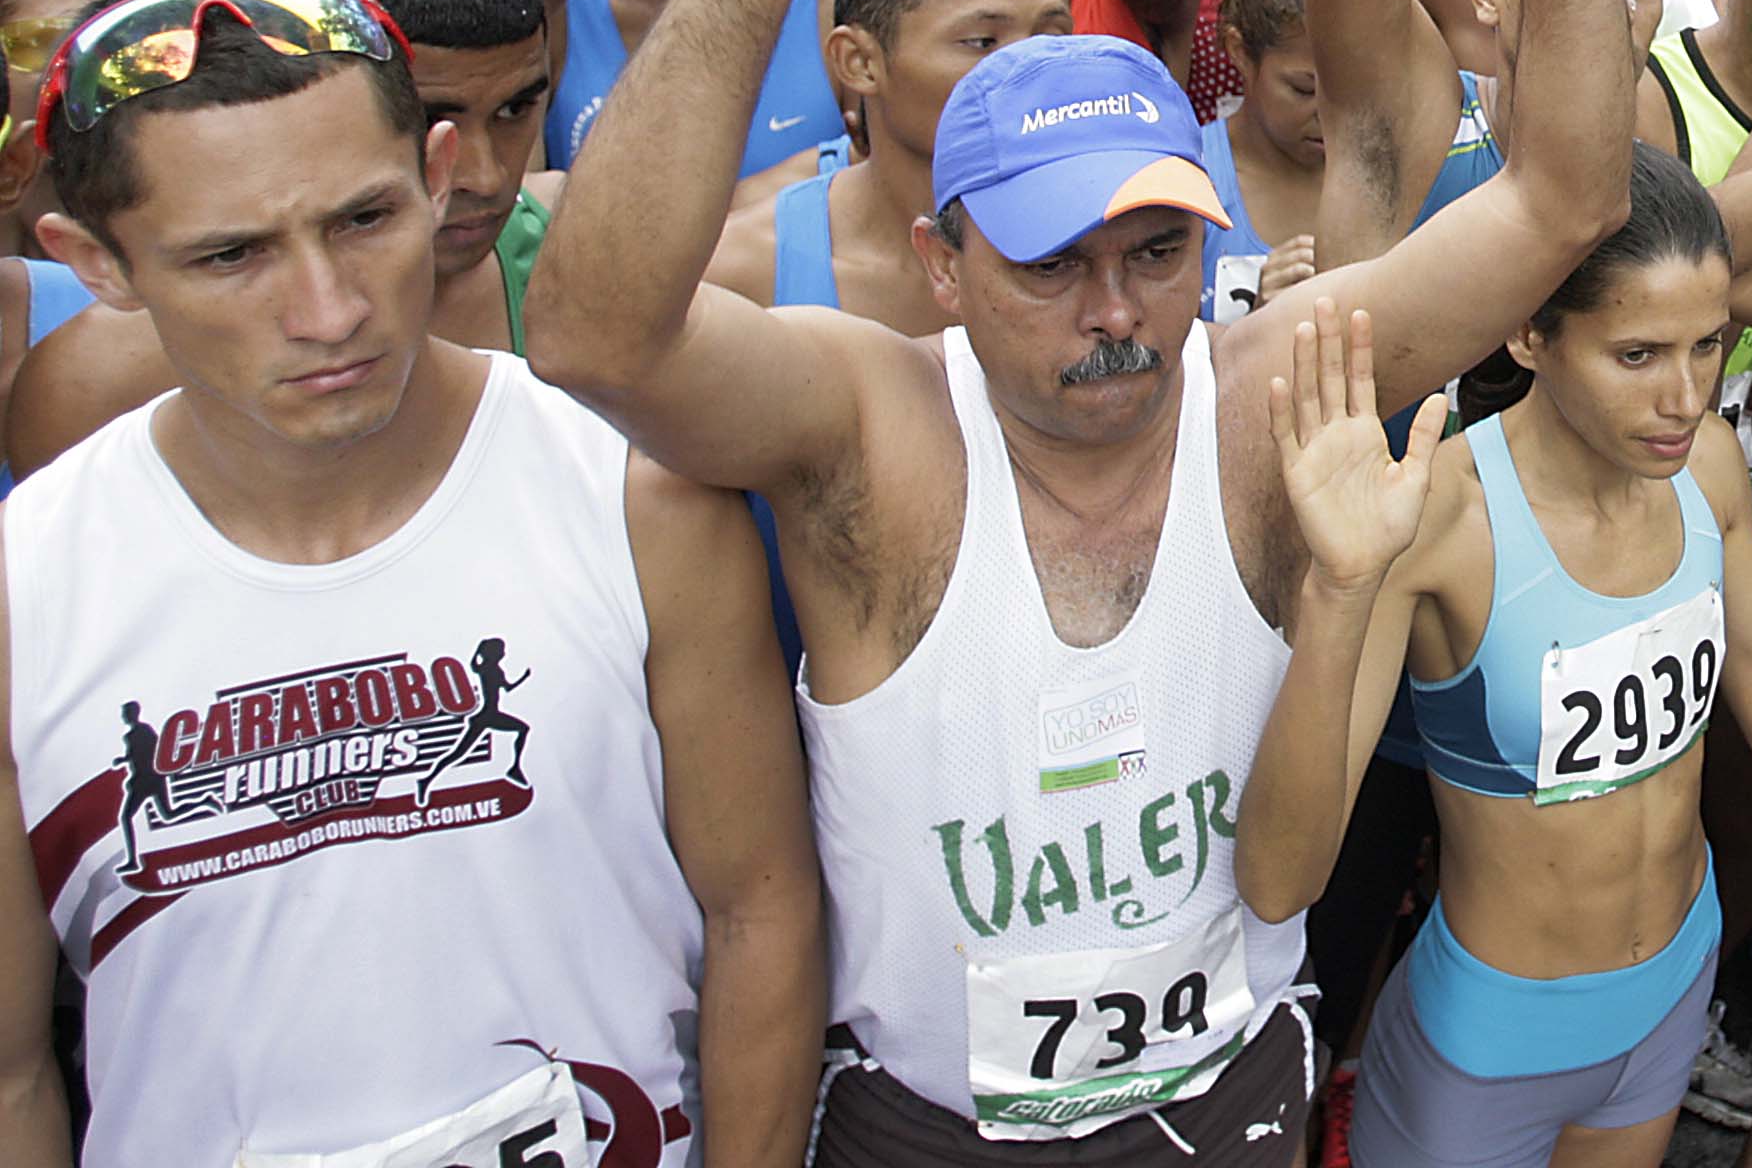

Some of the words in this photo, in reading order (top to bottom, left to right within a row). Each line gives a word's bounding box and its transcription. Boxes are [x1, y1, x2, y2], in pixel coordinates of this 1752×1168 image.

[1021, 94, 1131, 135] Mercantil
[155, 657, 479, 775] CARABOBO
[1556, 639, 1716, 775] 2939
[222, 730, 420, 804] runners
[297, 780, 361, 817] CLUB
[157, 797, 502, 887] WWW.CARABOBORUNNERS.COM.VE
[1024, 971, 1208, 1080] 739
